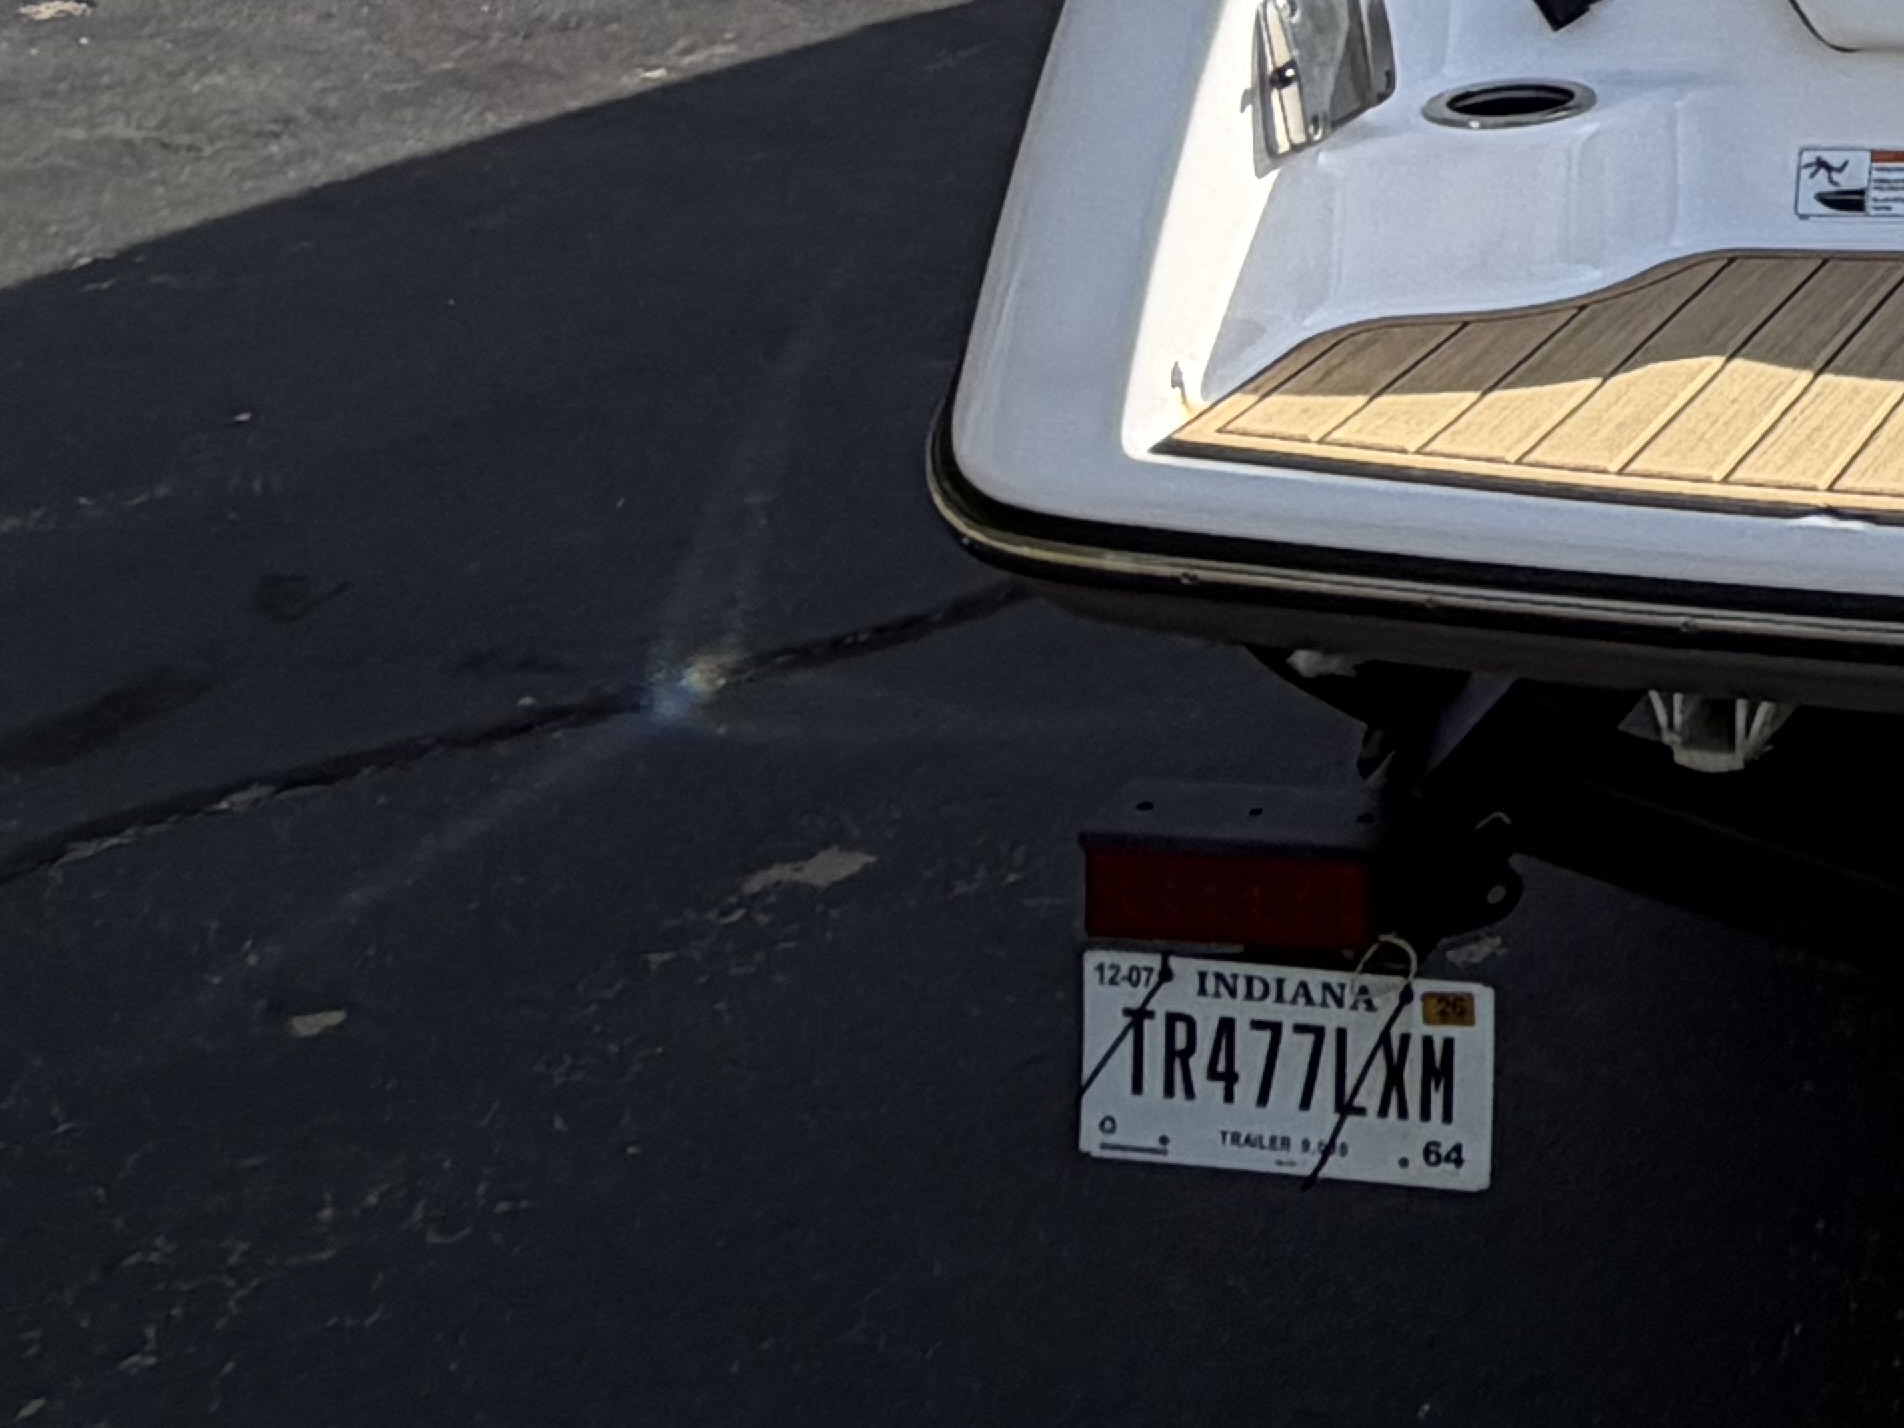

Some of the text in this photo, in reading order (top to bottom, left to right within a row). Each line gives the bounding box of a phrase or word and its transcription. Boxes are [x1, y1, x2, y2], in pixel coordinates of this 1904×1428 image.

[1094, 962, 1154, 989] 12-07
[1196, 970, 1379, 1013] INDIANA
[1121, 1006, 1455, 1126] TR477LXM
[1219, 1129, 1292, 1153] TRAILER
[1421, 1141, 1466, 1171] 64
